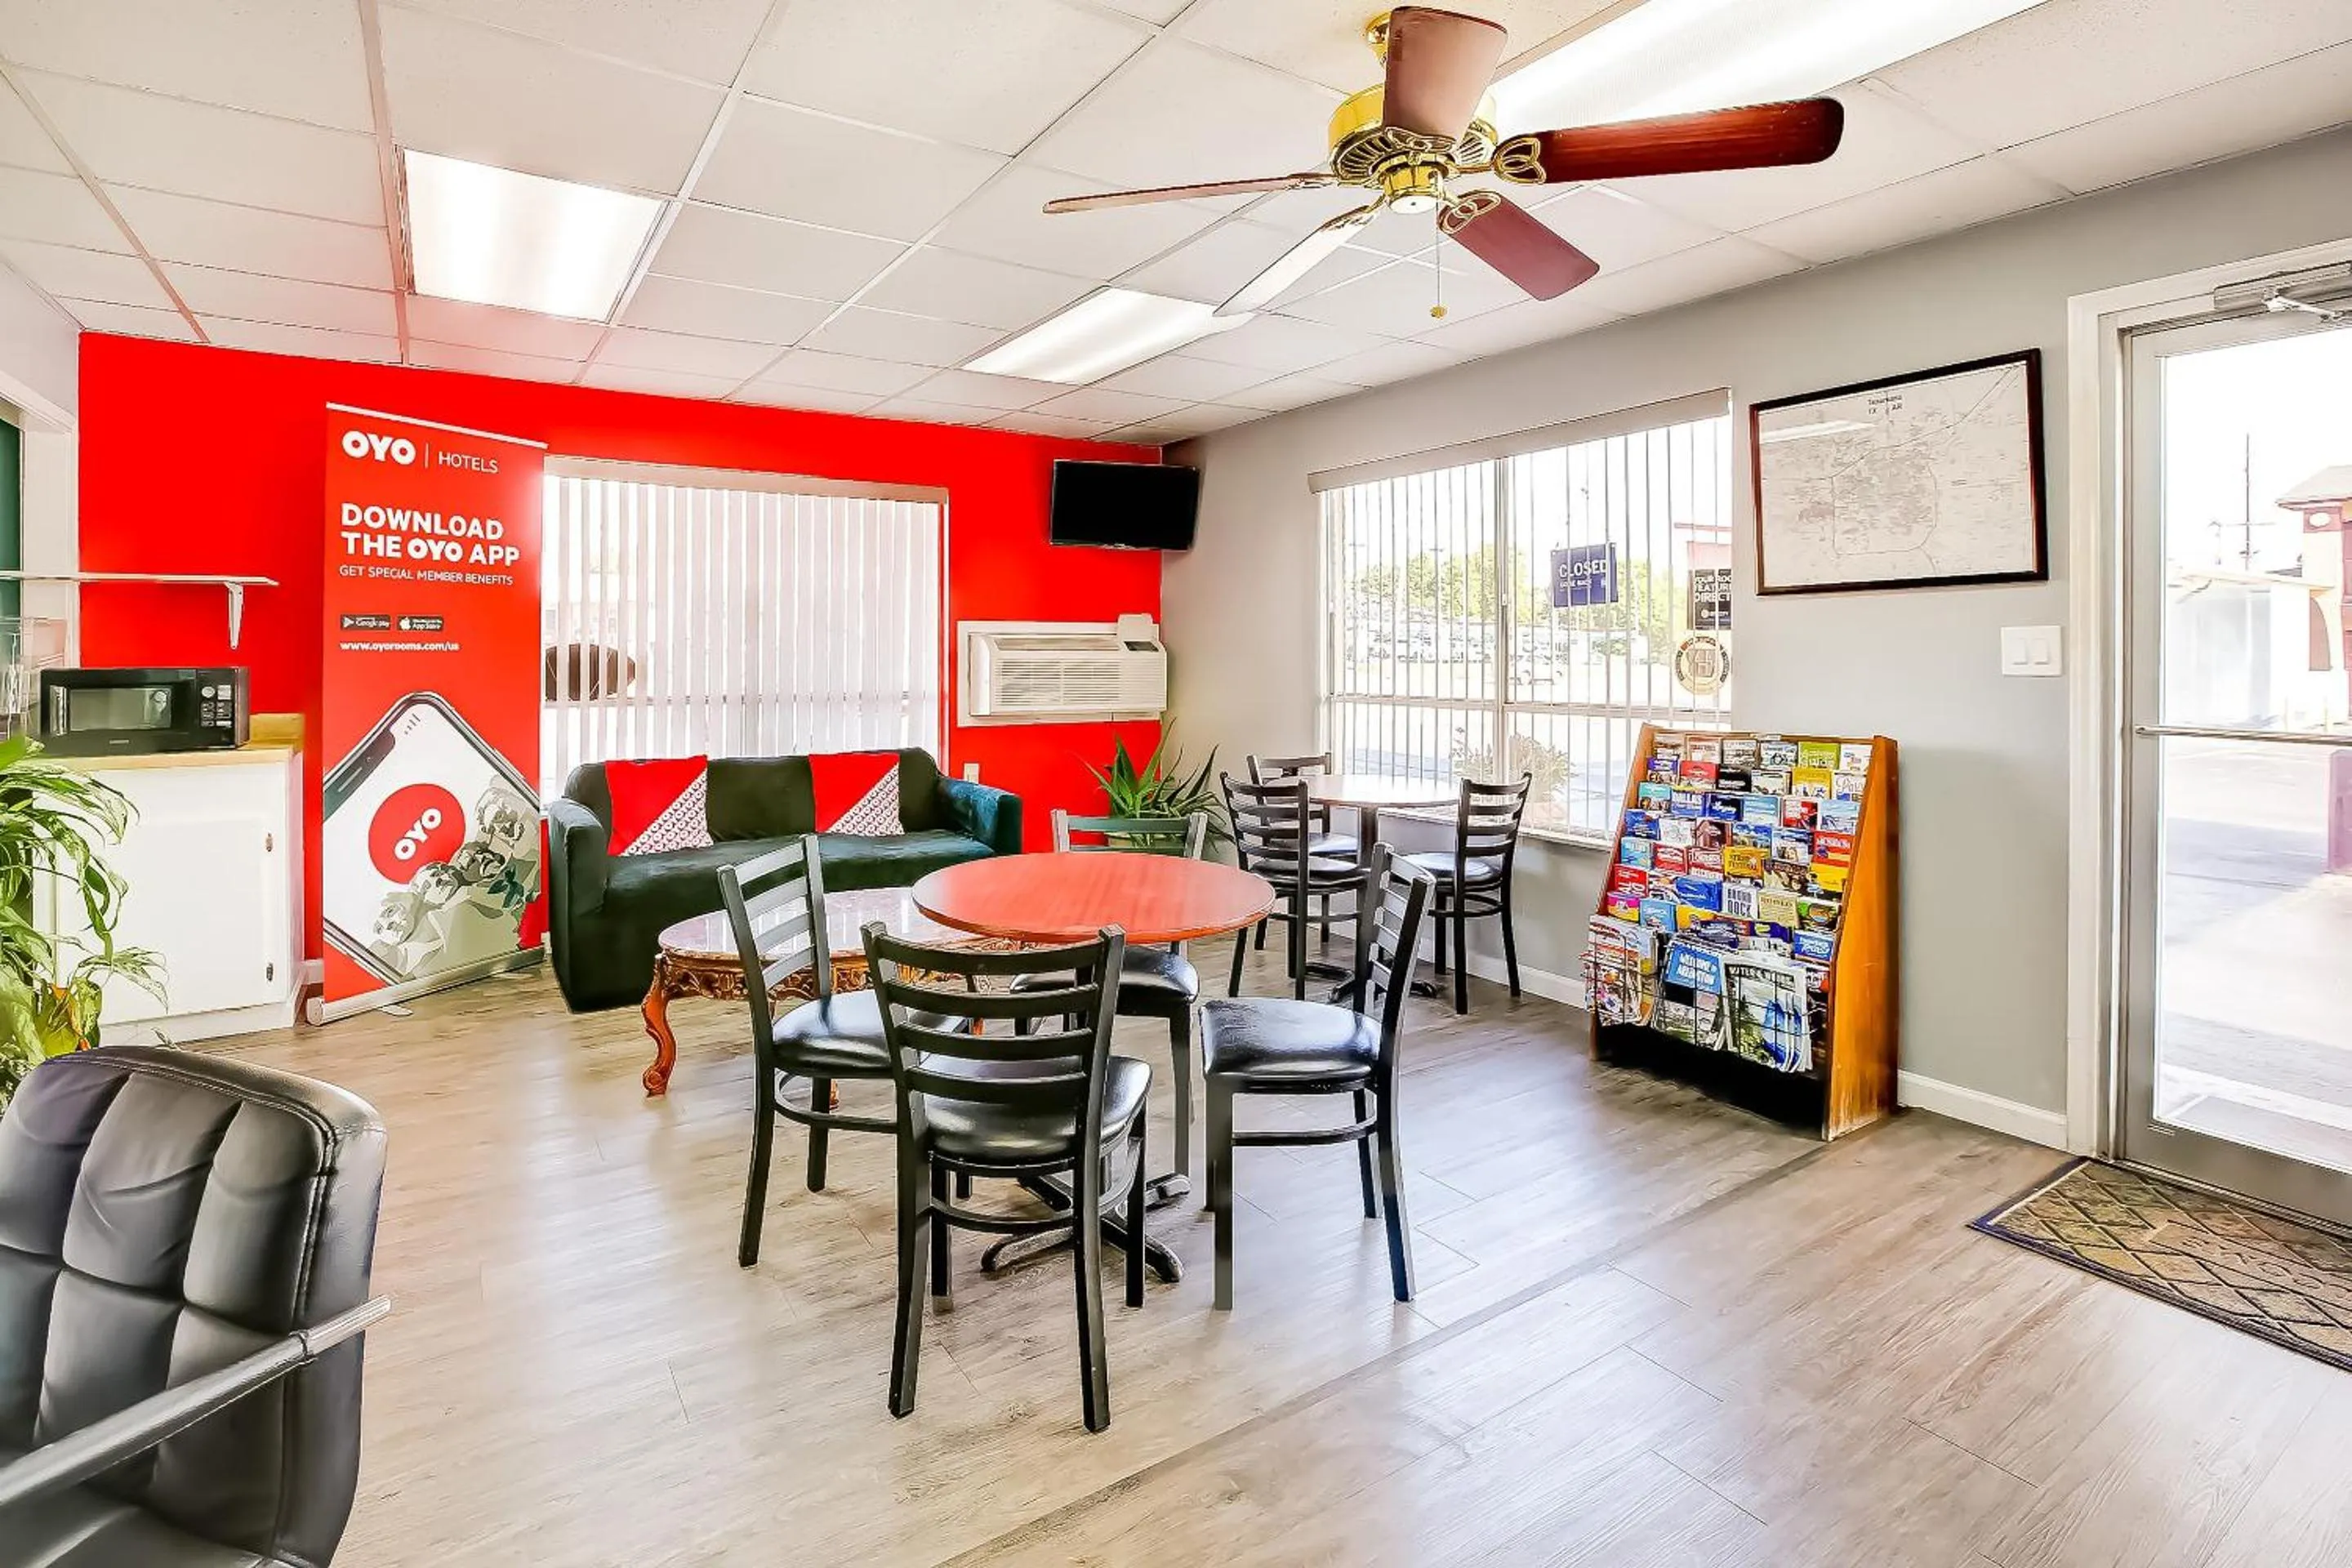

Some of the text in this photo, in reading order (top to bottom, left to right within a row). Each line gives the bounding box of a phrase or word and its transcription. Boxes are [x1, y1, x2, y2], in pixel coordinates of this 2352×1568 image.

[341, 430, 498, 474] OYO HOTELS
[341, 502, 504, 541] DOWNLOAD
[340, 531, 520, 567] THE OYO APP
[340, 565, 514, 586] GET SPECIAL MEMBER BENEFITS
[340, 641, 460, 653] www.oyorooms.com/us
[394, 808, 442, 861] OYO
